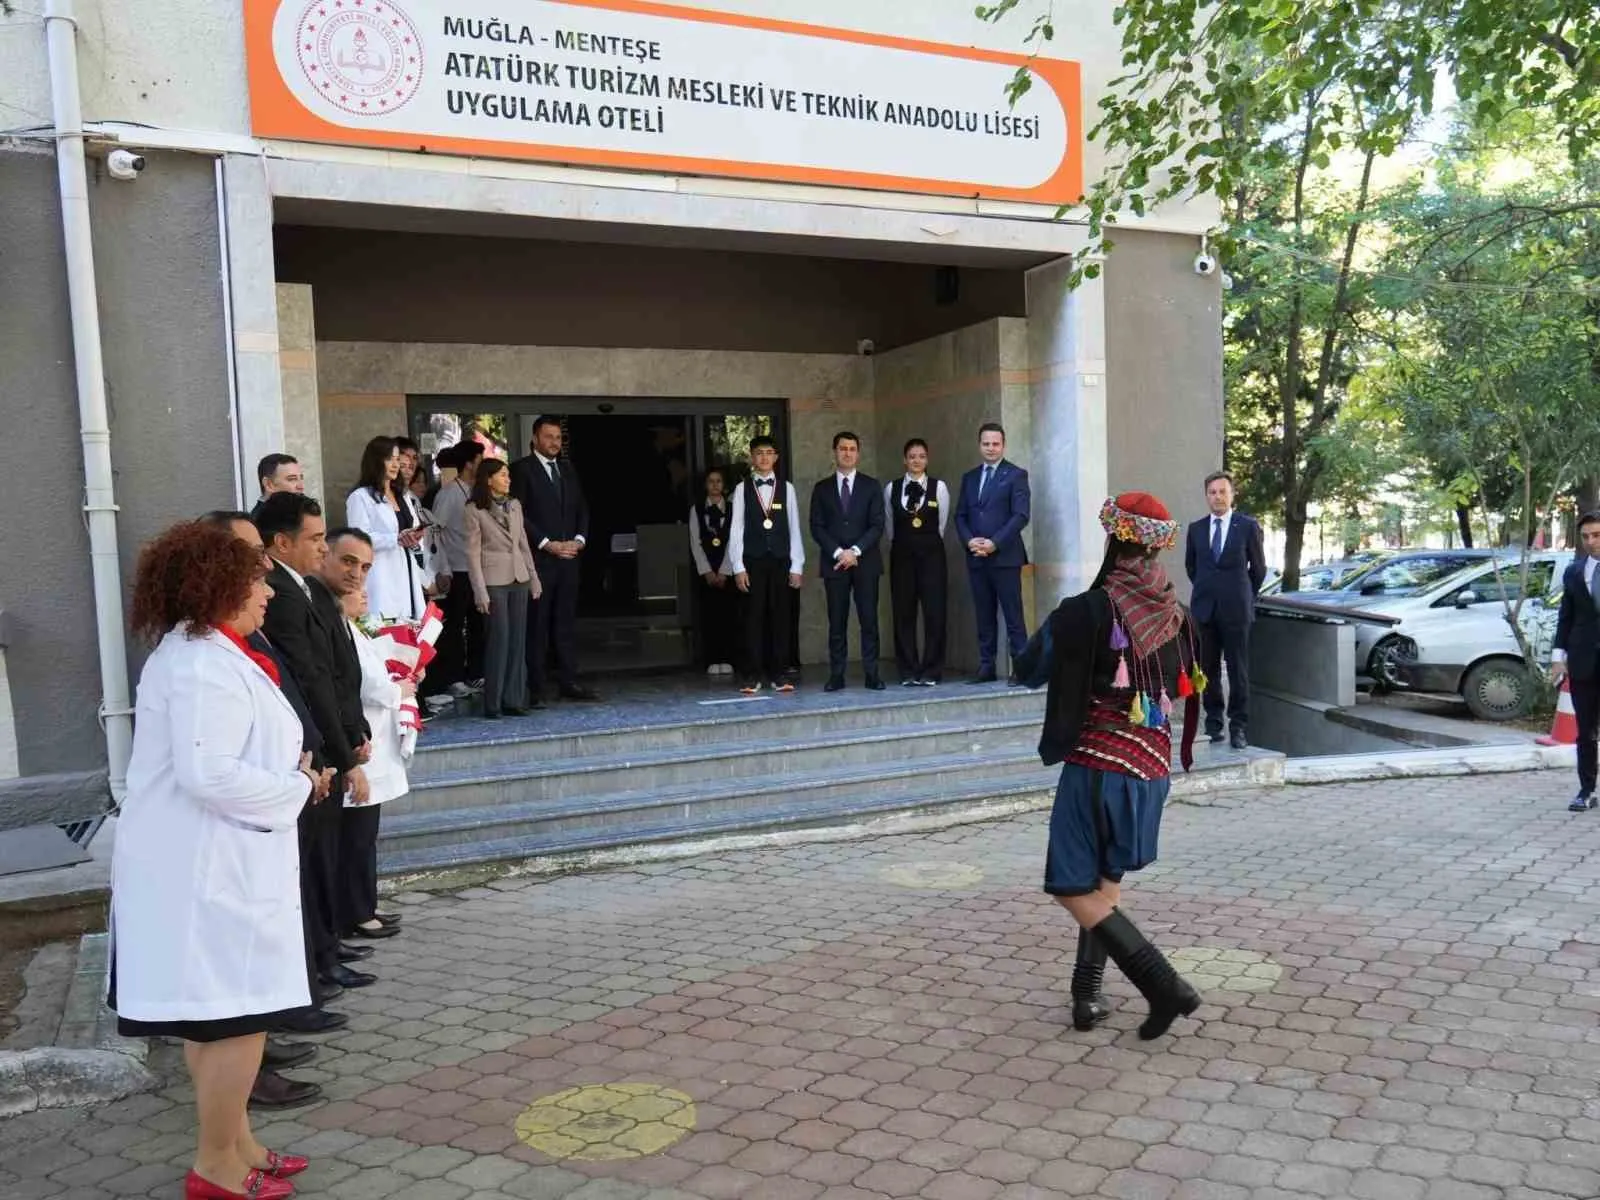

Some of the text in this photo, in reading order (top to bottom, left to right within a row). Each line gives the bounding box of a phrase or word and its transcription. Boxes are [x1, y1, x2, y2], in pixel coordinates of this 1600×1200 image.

[443, 15, 535, 46] MUĞLA
[554, 29, 662, 64] MENTEŞE
[444, 52, 1040, 140] ATATÜRK TURİZM MESLEKİ VE TEKNİK ANADOLU LİSESİ
[447, 89, 664, 133] UYGULAMA OTELİ
